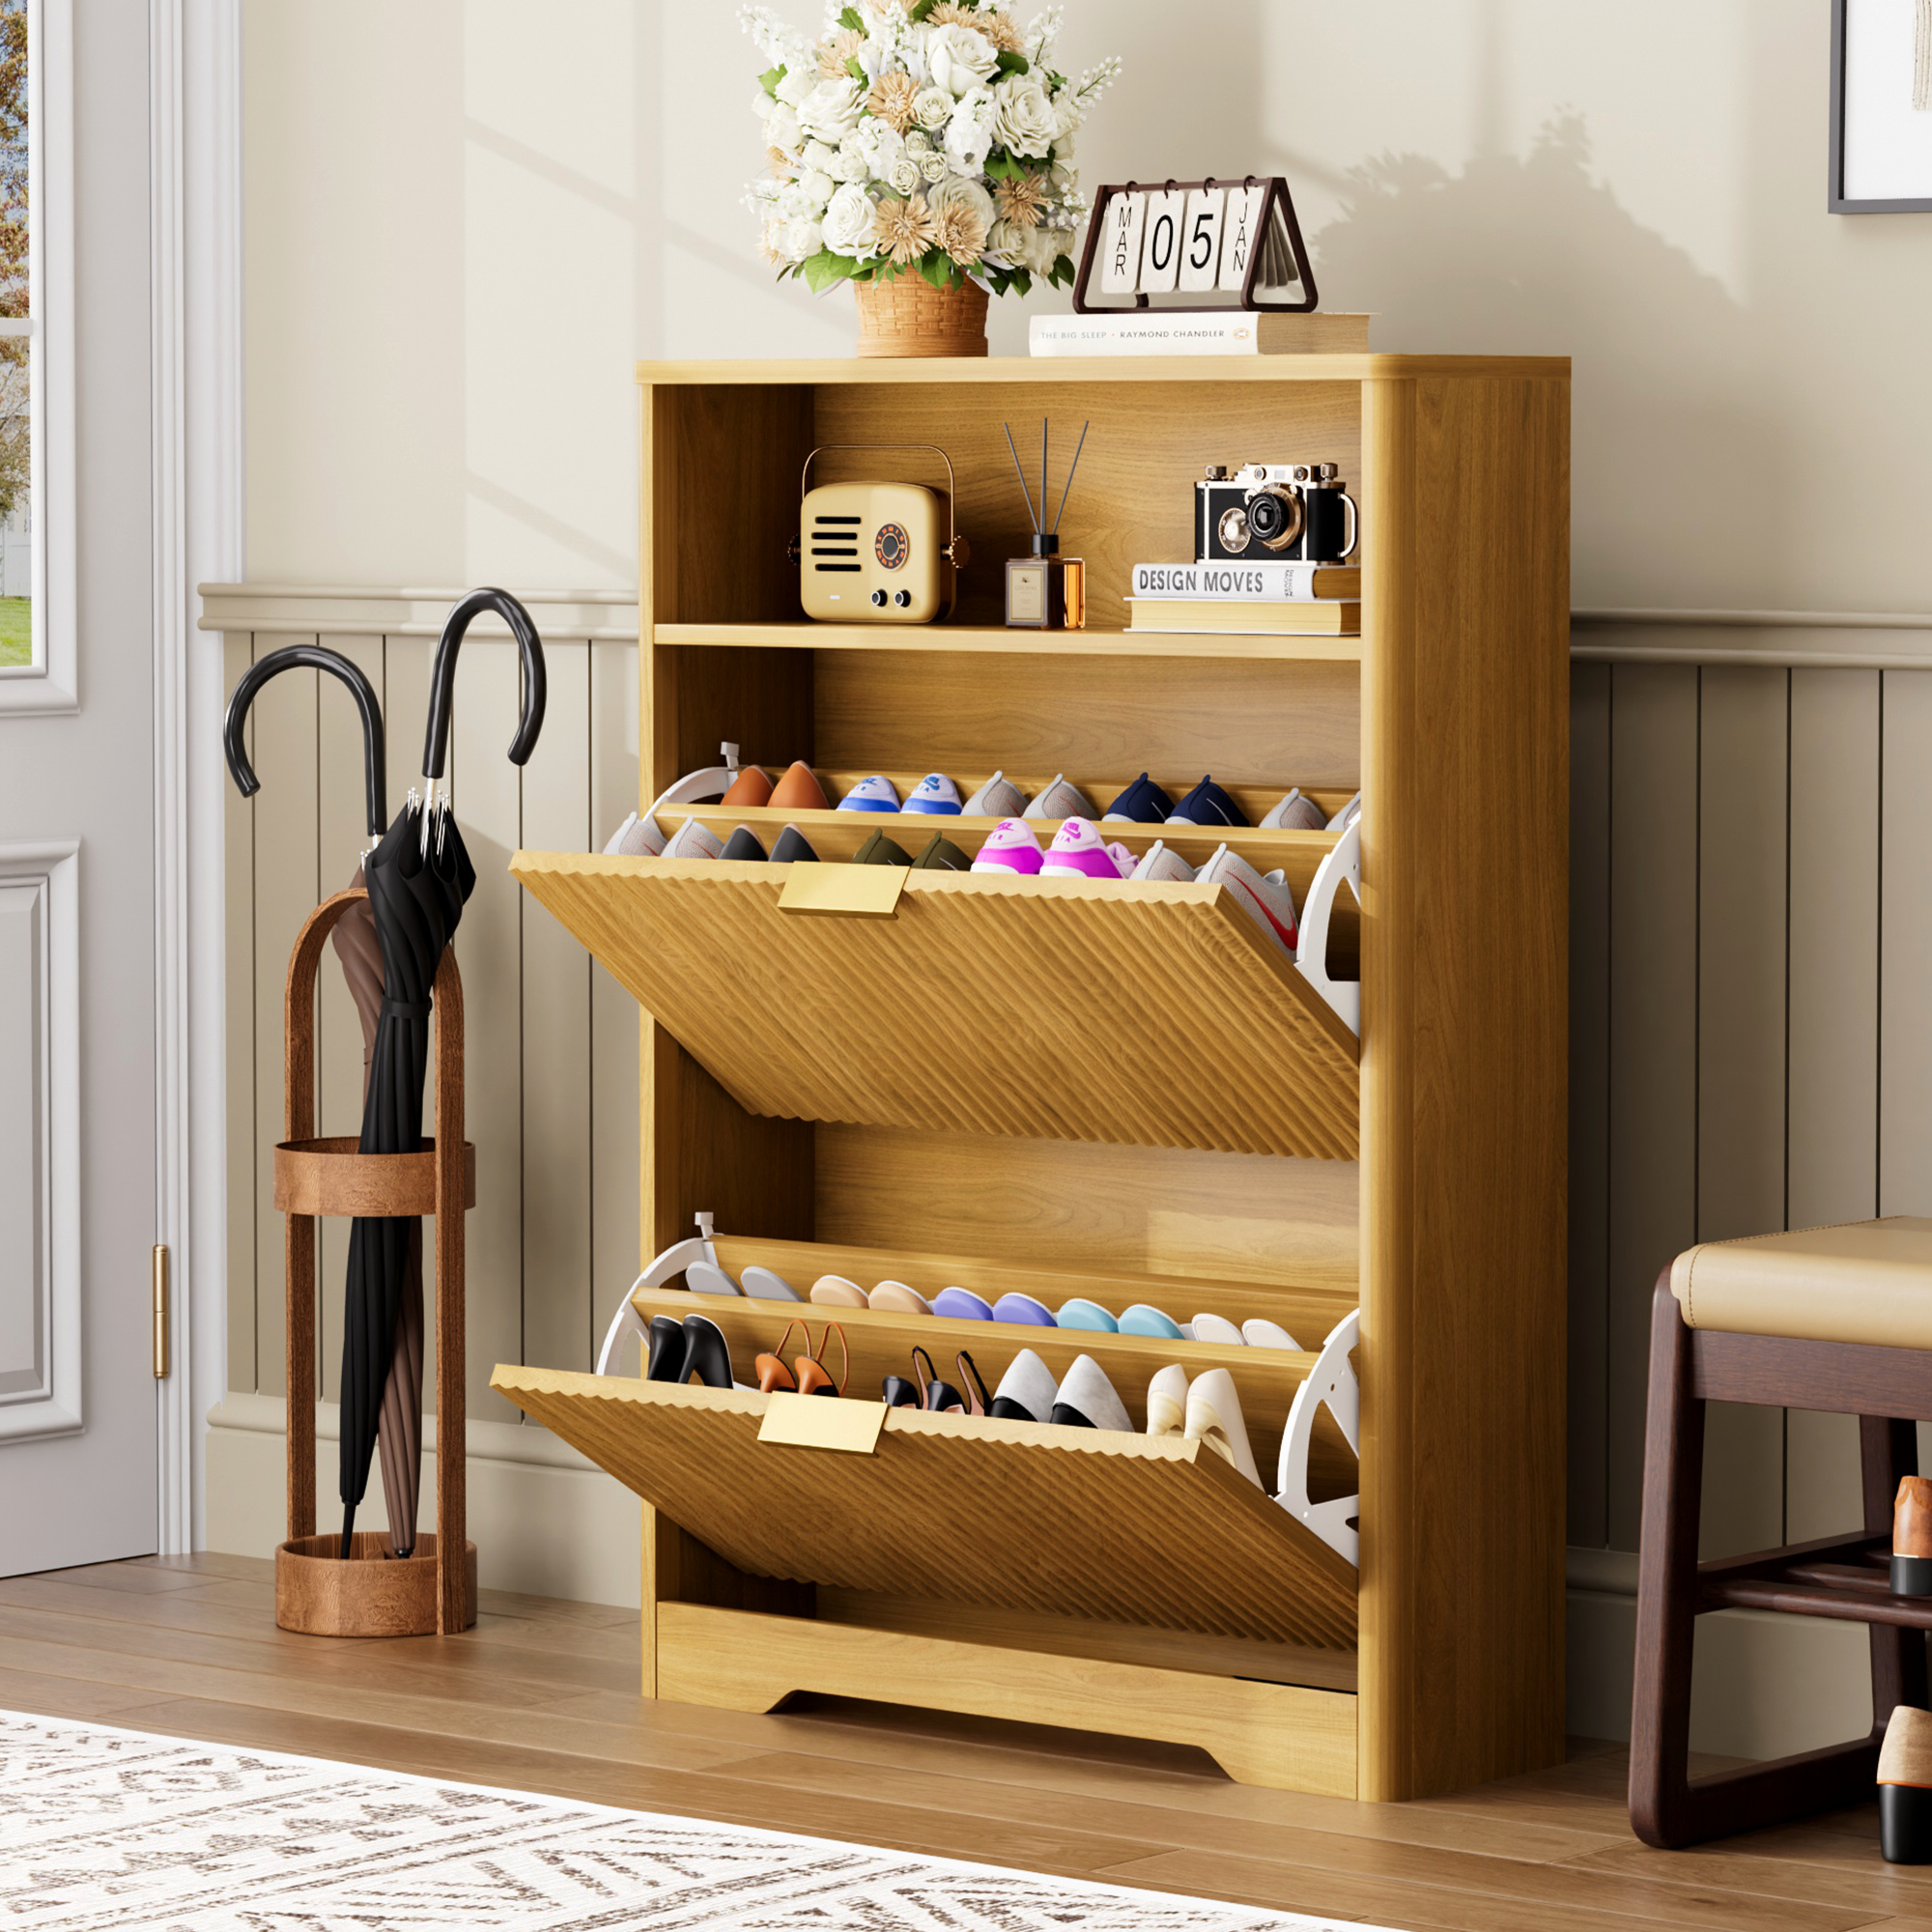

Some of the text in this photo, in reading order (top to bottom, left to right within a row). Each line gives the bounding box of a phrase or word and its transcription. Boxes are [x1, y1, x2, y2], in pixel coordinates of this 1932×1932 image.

[1114, 206, 1132, 276] MAR
[1233, 202, 1248, 271] JAN
[1173, 329, 1225, 338] CHANDLER
[1140, 570, 1264, 593] DESIGN MOVES
